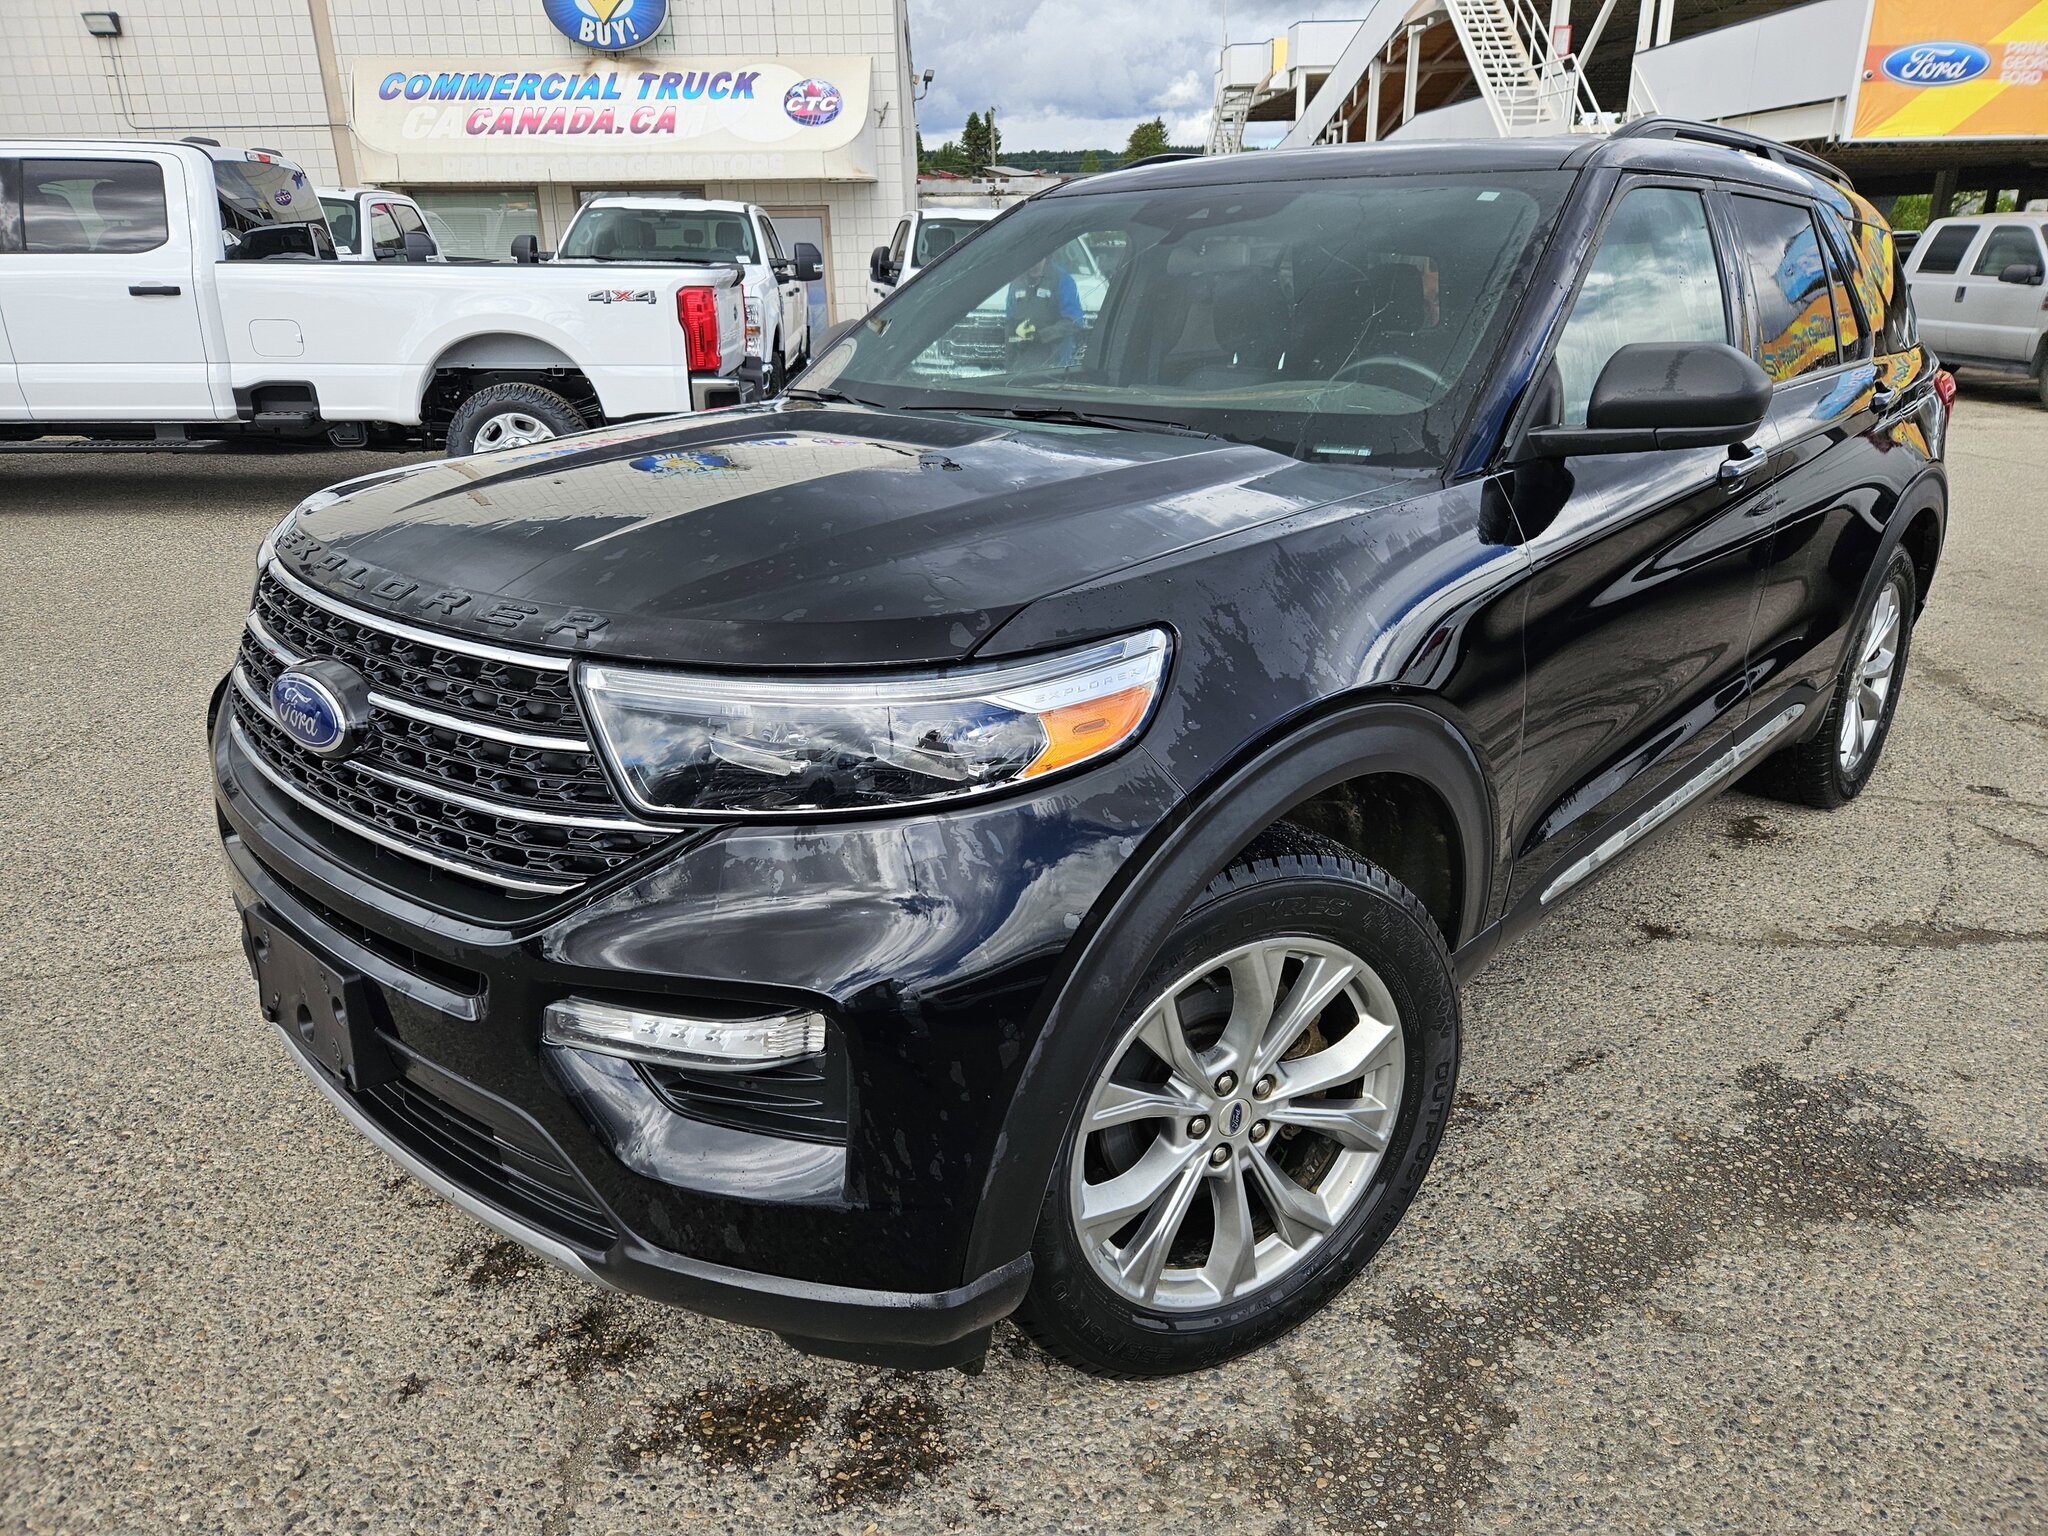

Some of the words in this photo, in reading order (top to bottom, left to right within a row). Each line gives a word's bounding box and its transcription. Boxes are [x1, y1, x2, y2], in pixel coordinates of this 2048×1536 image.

[579, 16, 639, 45] BUY!
[1902, 48, 1971, 79] Ford
[2000, 70, 2043, 84] FORD
[378, 71, 622, 101] COMMERCIAL
[637, 71, 761, 100] TRUCK
[786, 96, 838, 112] CTC
[465, 106, 676, 135] CANADA.CA
[276, 527, 611, 640] EXPLORER
[280, 687, 321, 737] Ford
